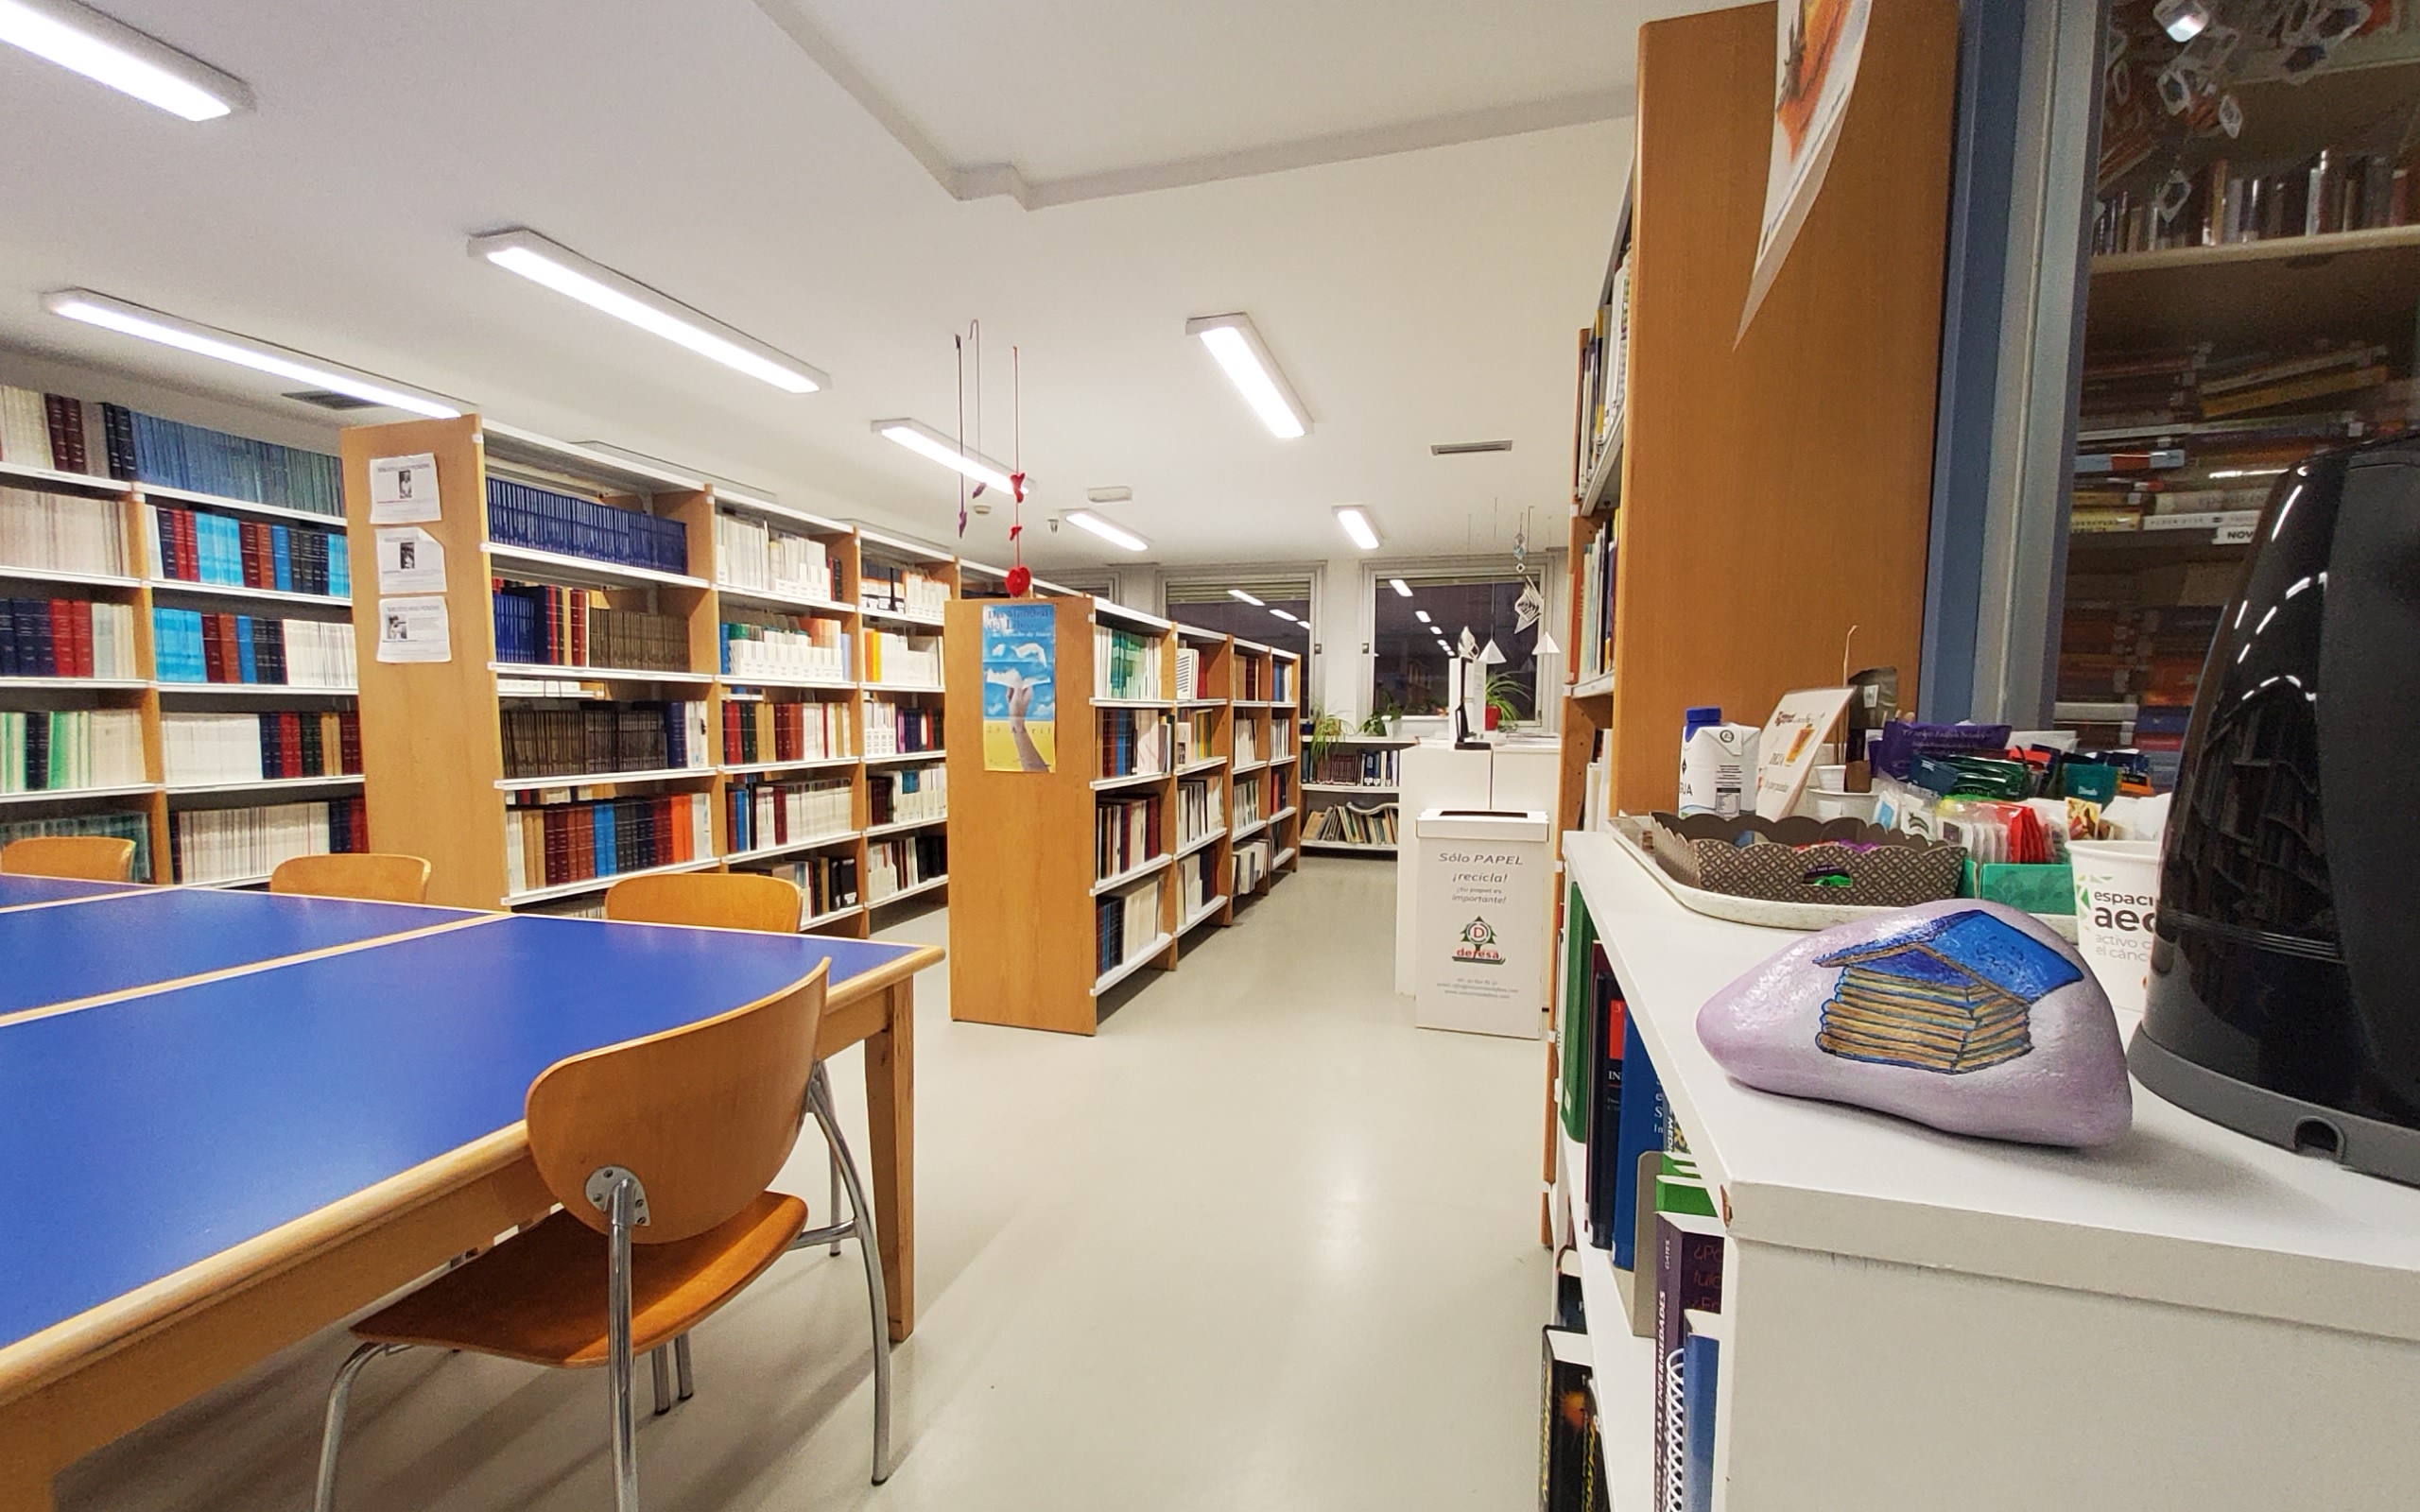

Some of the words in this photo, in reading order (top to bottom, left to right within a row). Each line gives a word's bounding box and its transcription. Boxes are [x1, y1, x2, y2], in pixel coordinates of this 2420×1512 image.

[1438, 852, 1471, 864] Sólo
[1474, 854, 1524, 866] PAPEL
[1452, 872, 1508, 884] ¡recicla!
[2094, 891, 2154, 907] espaci
[2094, 906, 2155, 934] aec
[1473, 927, 1485, 938] D
[2095, 934, 2138, 949] activo
[2096, 946, 2106, 955] el
[2109, 949, 2148, 962] cánc
[1608, 1070, 1620, 1081] IN
[1657, 1290, 1667, 1408] ENFERMEDADES
